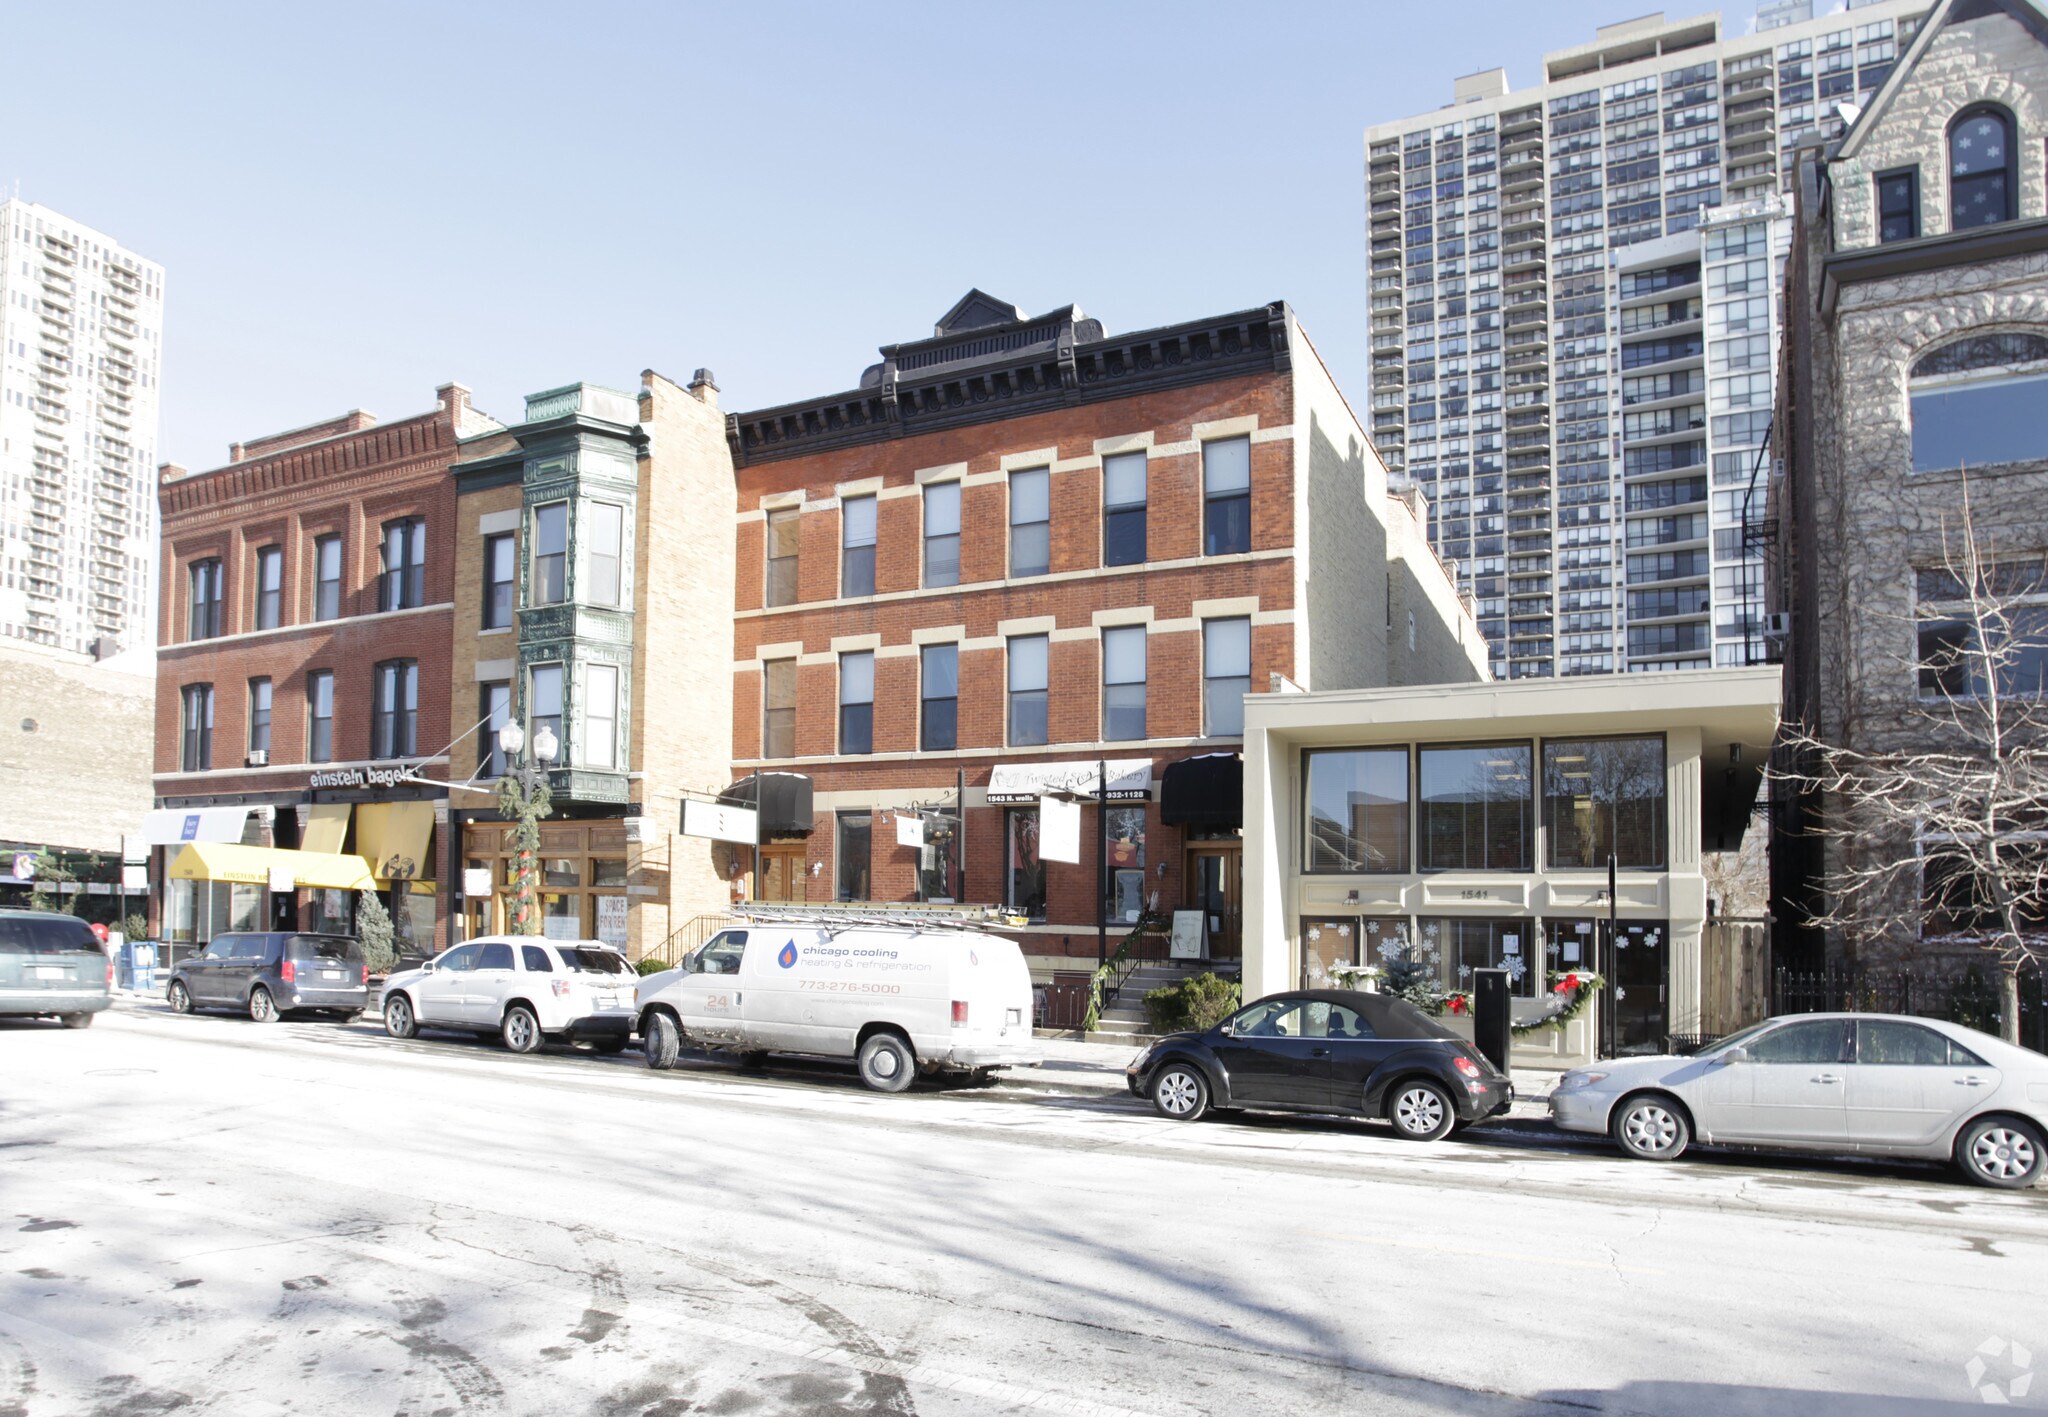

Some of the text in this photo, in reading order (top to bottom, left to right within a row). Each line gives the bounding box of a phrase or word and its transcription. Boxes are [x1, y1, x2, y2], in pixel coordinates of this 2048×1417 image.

[1024, 772, 1067, 785] Twisted
[1106, 769, 1148, 783] Bakery
[1089, 791, 1145, 799] 31-932-1128
[1461, 890, 1488, 900] 1541
[605, 899, 625, 913] SPACE
[600, 915, 612, 929] FOR
[803, 947, 899, 960] chicago cooling
[800, 958, 932, 972] heating & refrigeration
[799, 980, 901, 994] 773-276-5000
[707, 995, 728, 1007] 24
[703, 1005, 729, 1013] hours
